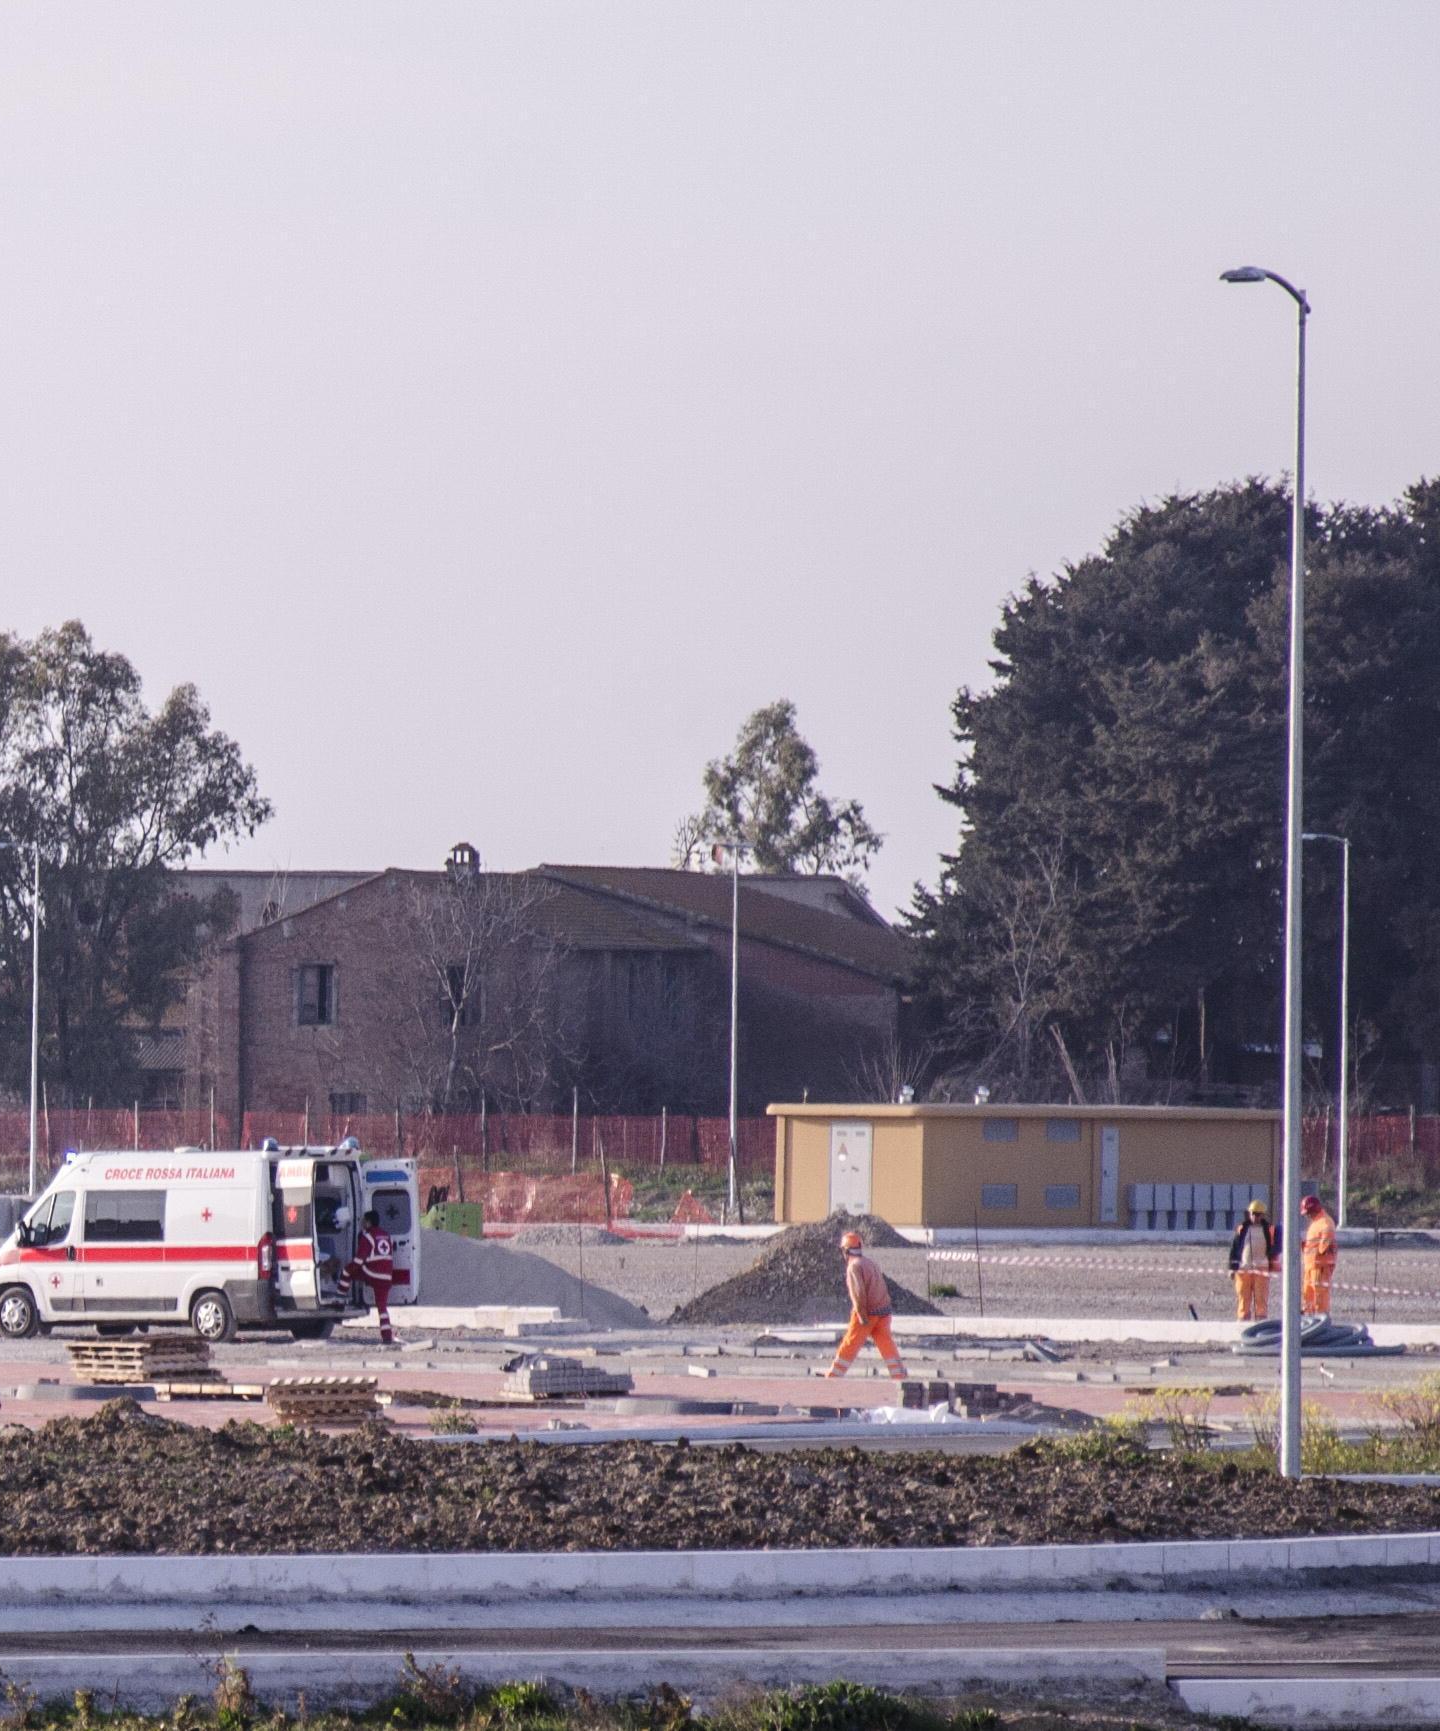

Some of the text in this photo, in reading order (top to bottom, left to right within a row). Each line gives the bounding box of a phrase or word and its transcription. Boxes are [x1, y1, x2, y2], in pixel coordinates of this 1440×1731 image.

[104, 1167, 236, 1180] CROCE ROSSA ITALIANA
